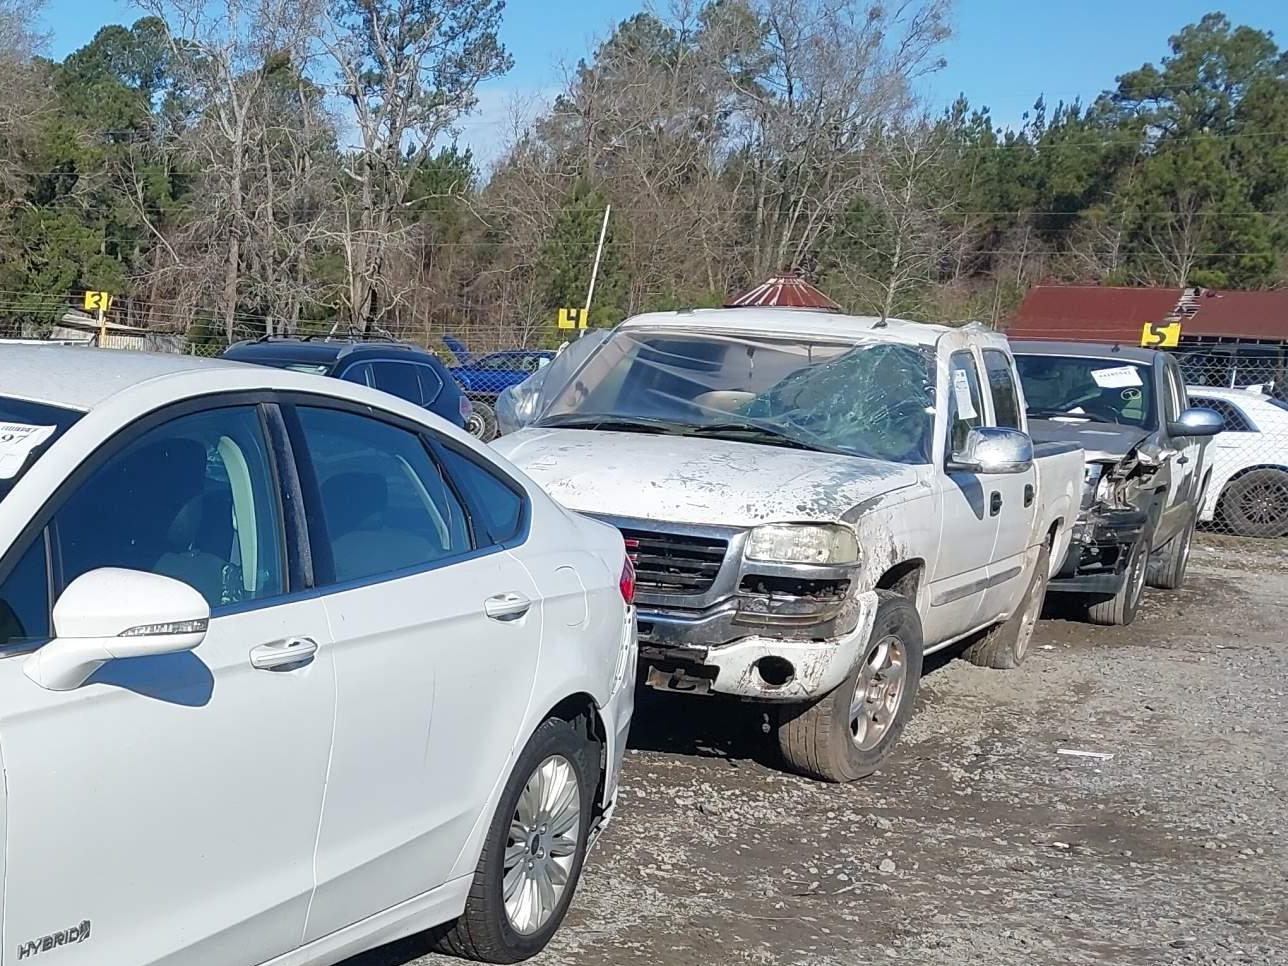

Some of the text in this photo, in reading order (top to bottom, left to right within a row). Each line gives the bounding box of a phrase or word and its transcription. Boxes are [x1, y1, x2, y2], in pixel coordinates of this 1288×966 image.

[90, 294, 102, 309] 3
[567, 308, 581, 329] 4
[1146, 322, 1171, 345] 5
[16, 926, 81, 961] HYBRID
